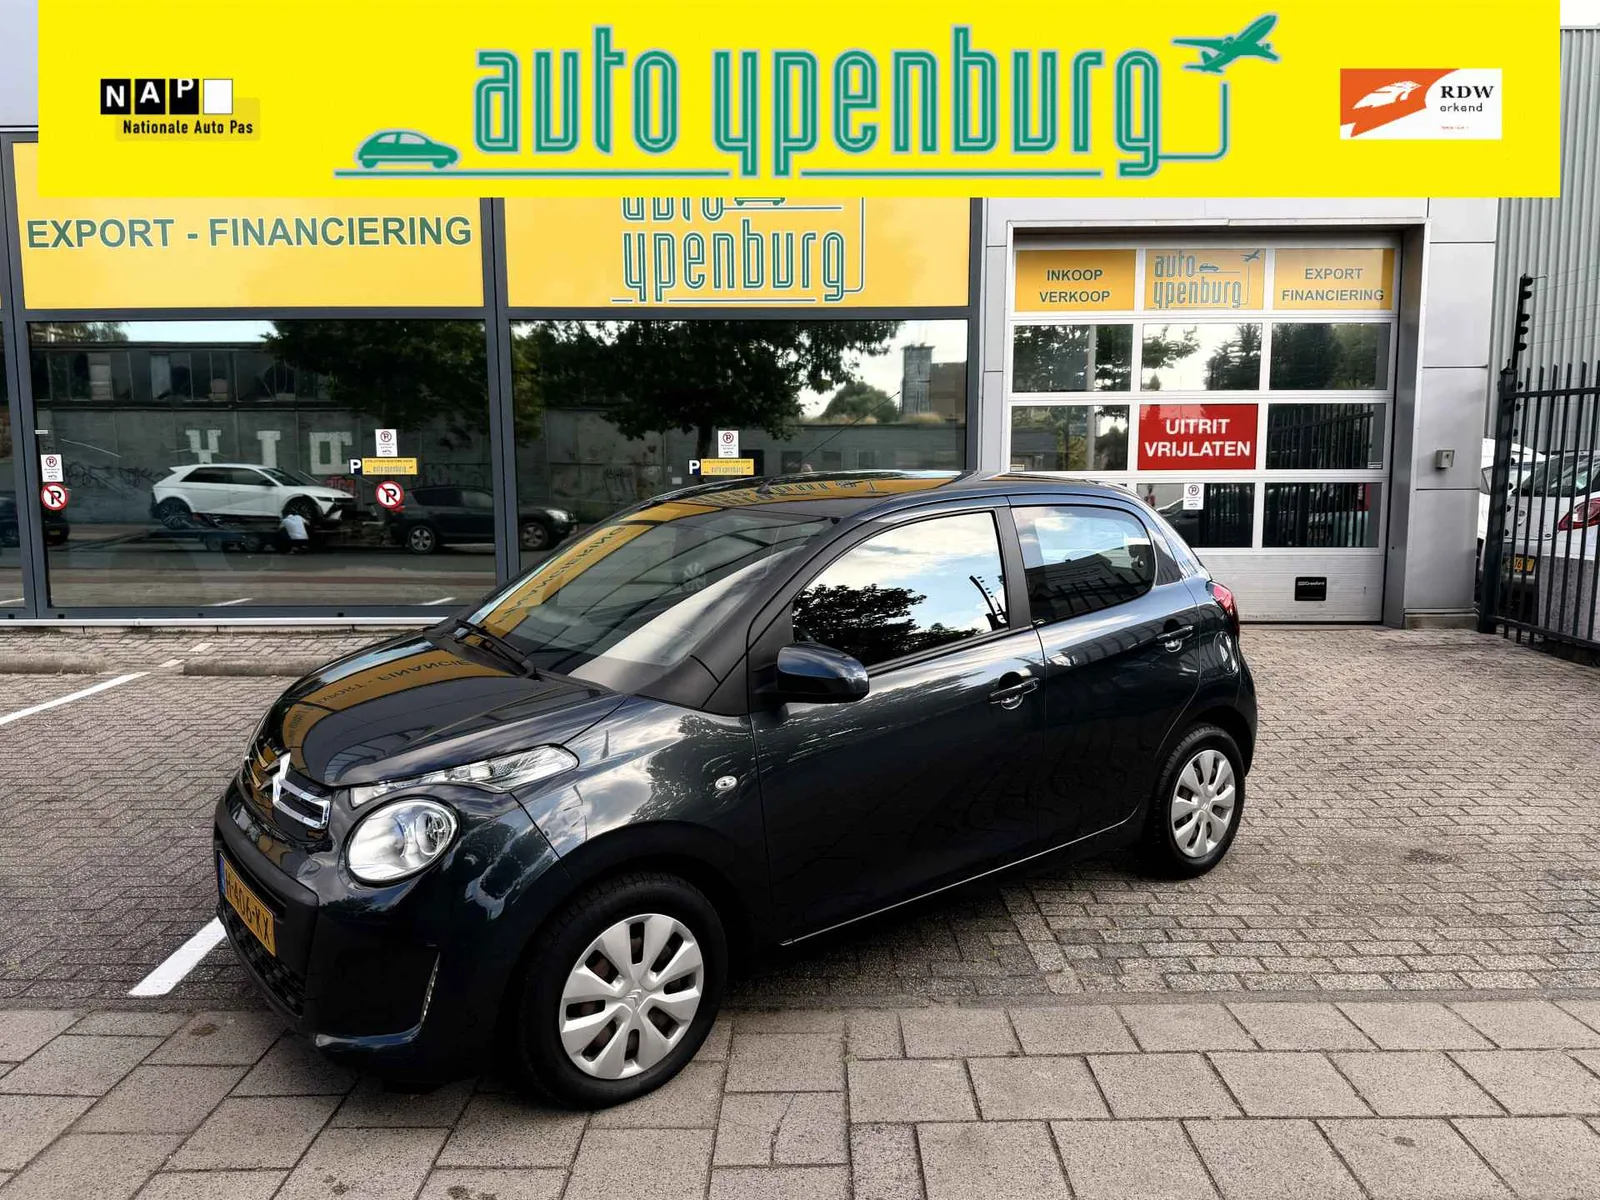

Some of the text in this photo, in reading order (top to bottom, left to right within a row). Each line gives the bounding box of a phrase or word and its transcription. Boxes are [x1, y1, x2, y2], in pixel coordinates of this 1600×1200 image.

[27, 219, 174, 248] EXPORT
[209, 216, 471, 246] FINANCIERING
[622, 218, 845, 302] ypenburg
[1154, 250, 1196, 278] auto
[1046, 269, 1103, 281] INKOOP
[1304, 267, 1363, 280] EXPORT
[1039, 290, 1110, 303] VERKOOP
[1153, 275, 1241, 309] ypenburg
[1281, 289, 1384, 301] FINANCIERING
[1165, 418, 1230, 435] UITRIT
[1144, 440, 1251, 458] VRIJLATEN
